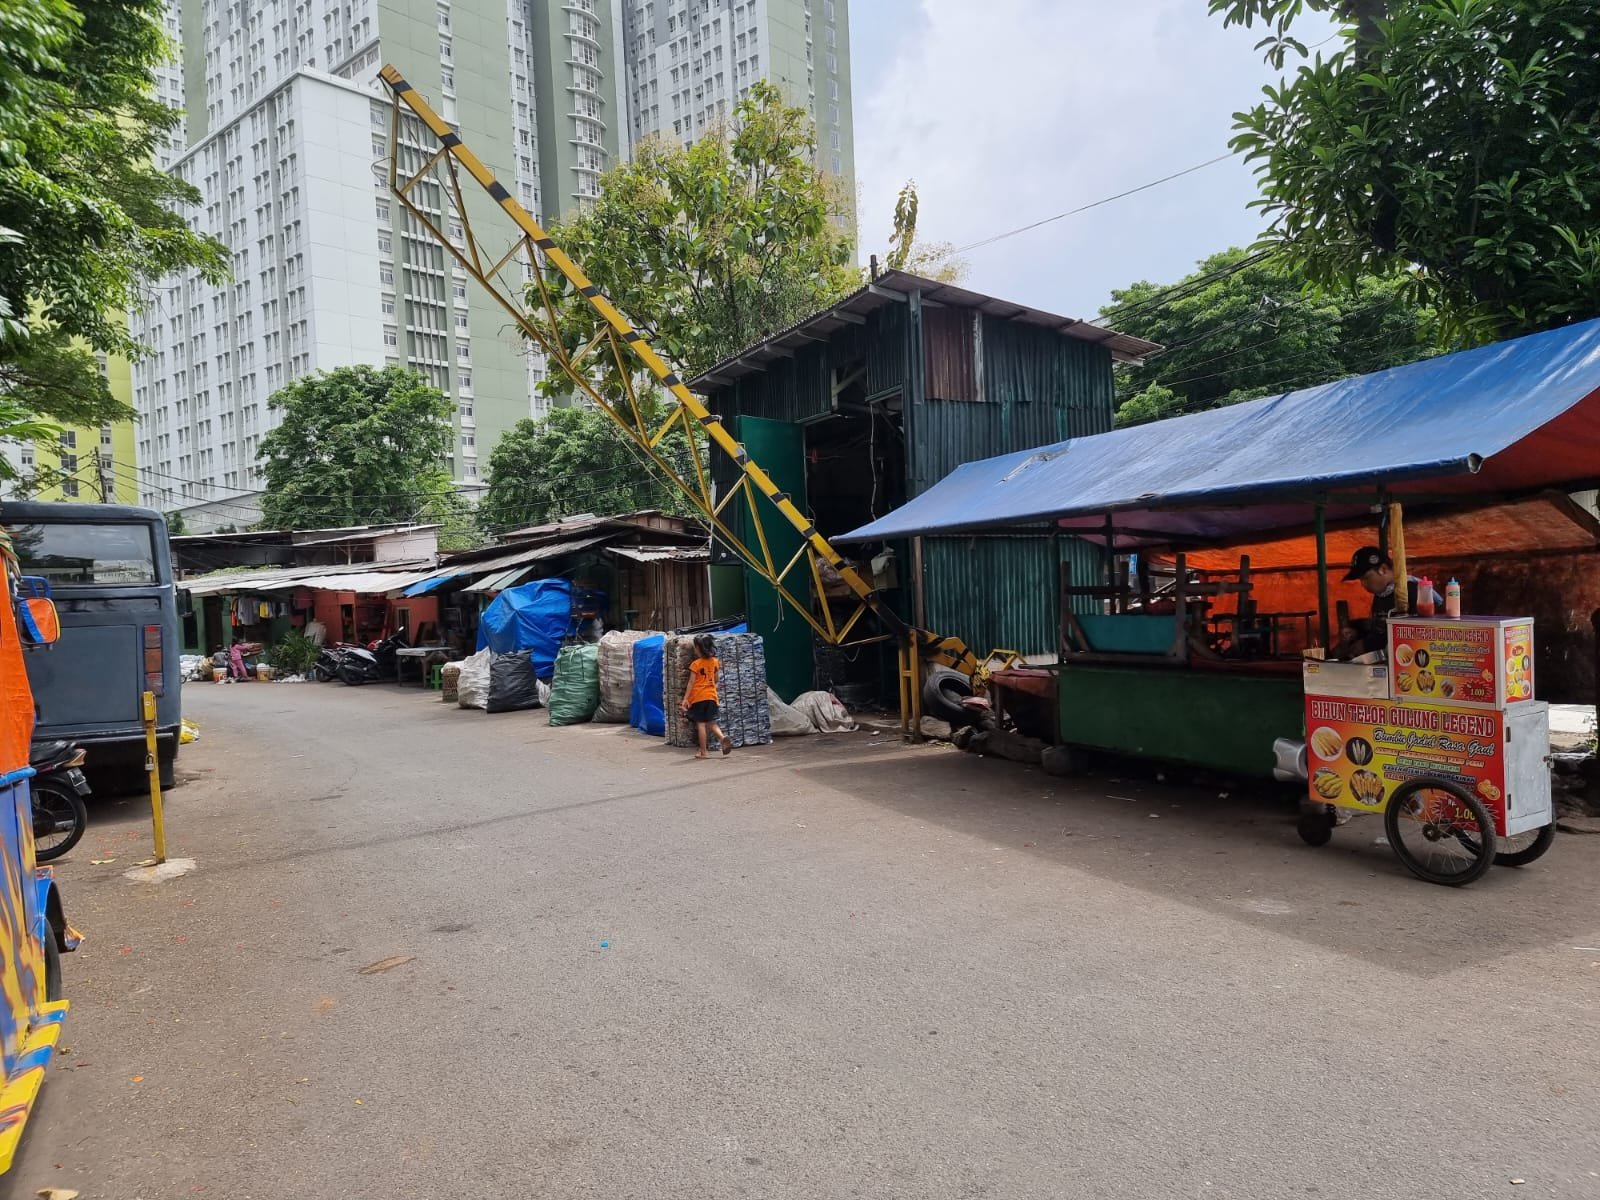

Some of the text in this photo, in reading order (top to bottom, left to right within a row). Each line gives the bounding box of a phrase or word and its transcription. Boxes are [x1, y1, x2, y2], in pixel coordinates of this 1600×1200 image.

[1312, 701, 1495, 737] BIHUN TELOR GULUNG LEGEND
[1374, 728, 1495, 757] Bumbu Jadul Rasa Gaul
